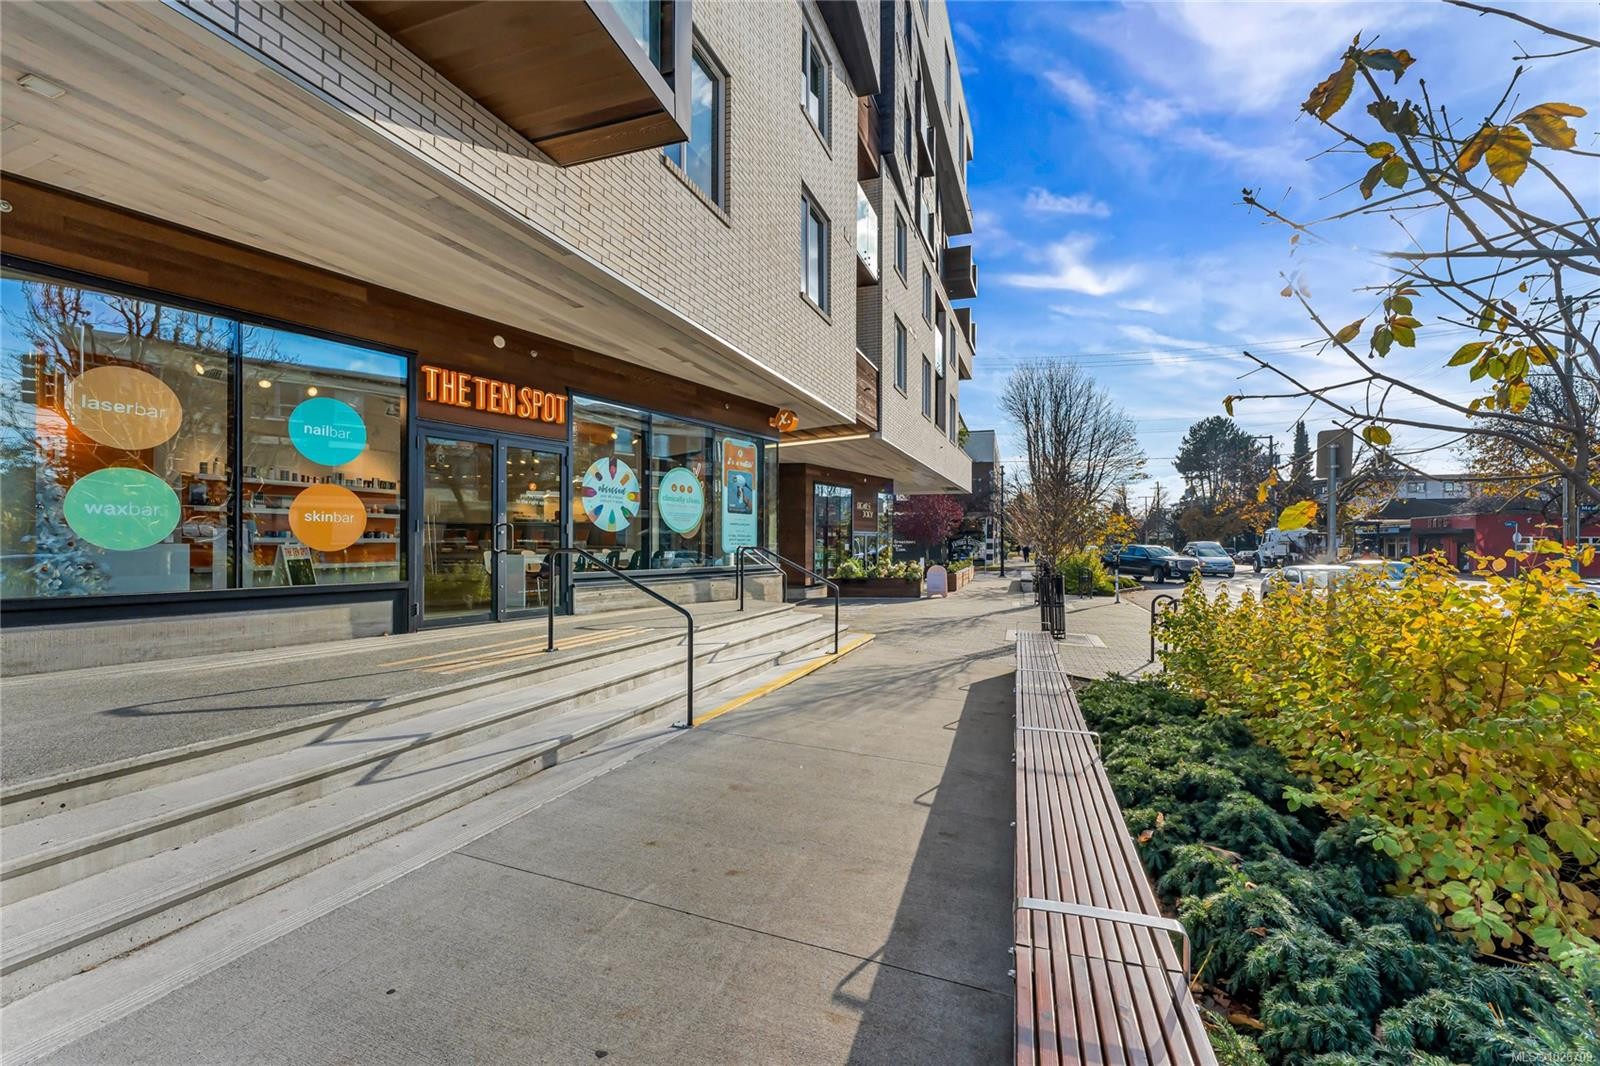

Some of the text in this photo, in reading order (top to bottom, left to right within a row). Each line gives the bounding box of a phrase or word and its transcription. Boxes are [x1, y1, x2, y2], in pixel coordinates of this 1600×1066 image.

[421, 365, 568, 424] THE TEN SPOT
[80, 394, 167, 419] laserbar
[84, 501, 160, 517] waxbar
[304, 510, 354, 524] skinbar
